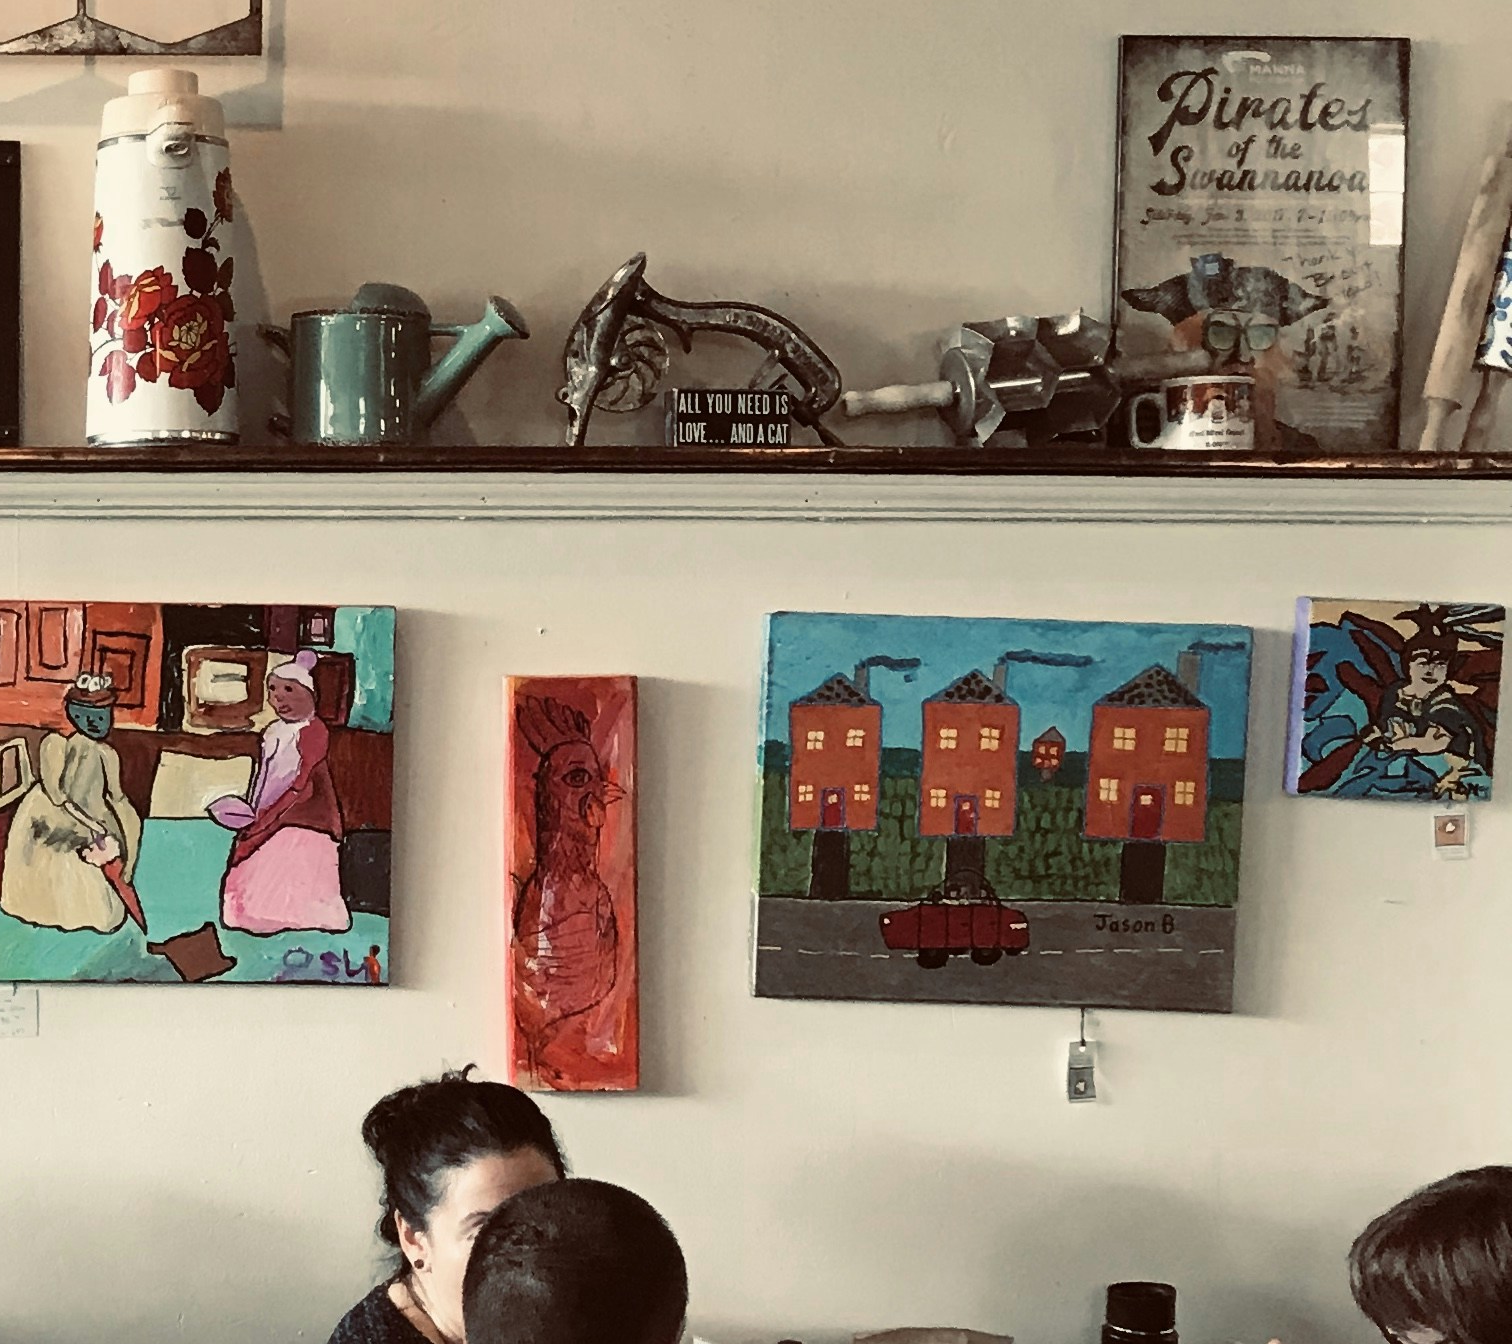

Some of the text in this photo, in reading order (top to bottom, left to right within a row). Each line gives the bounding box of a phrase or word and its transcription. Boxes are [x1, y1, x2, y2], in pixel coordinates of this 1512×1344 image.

[1147, 67, 1373, 156] Pirates
[1227, 134, 1304, 170] of the
[1150, 144, 1369, 196] Swannanoa
[678, 393, 789, 415] ALL YOU NEED IS
[729, 422, 754, 444] AND
[756, 423, 766, 444] A
[767, 423, 789, 444] CAT
[1093, 913, 1175, 935] Jason B
